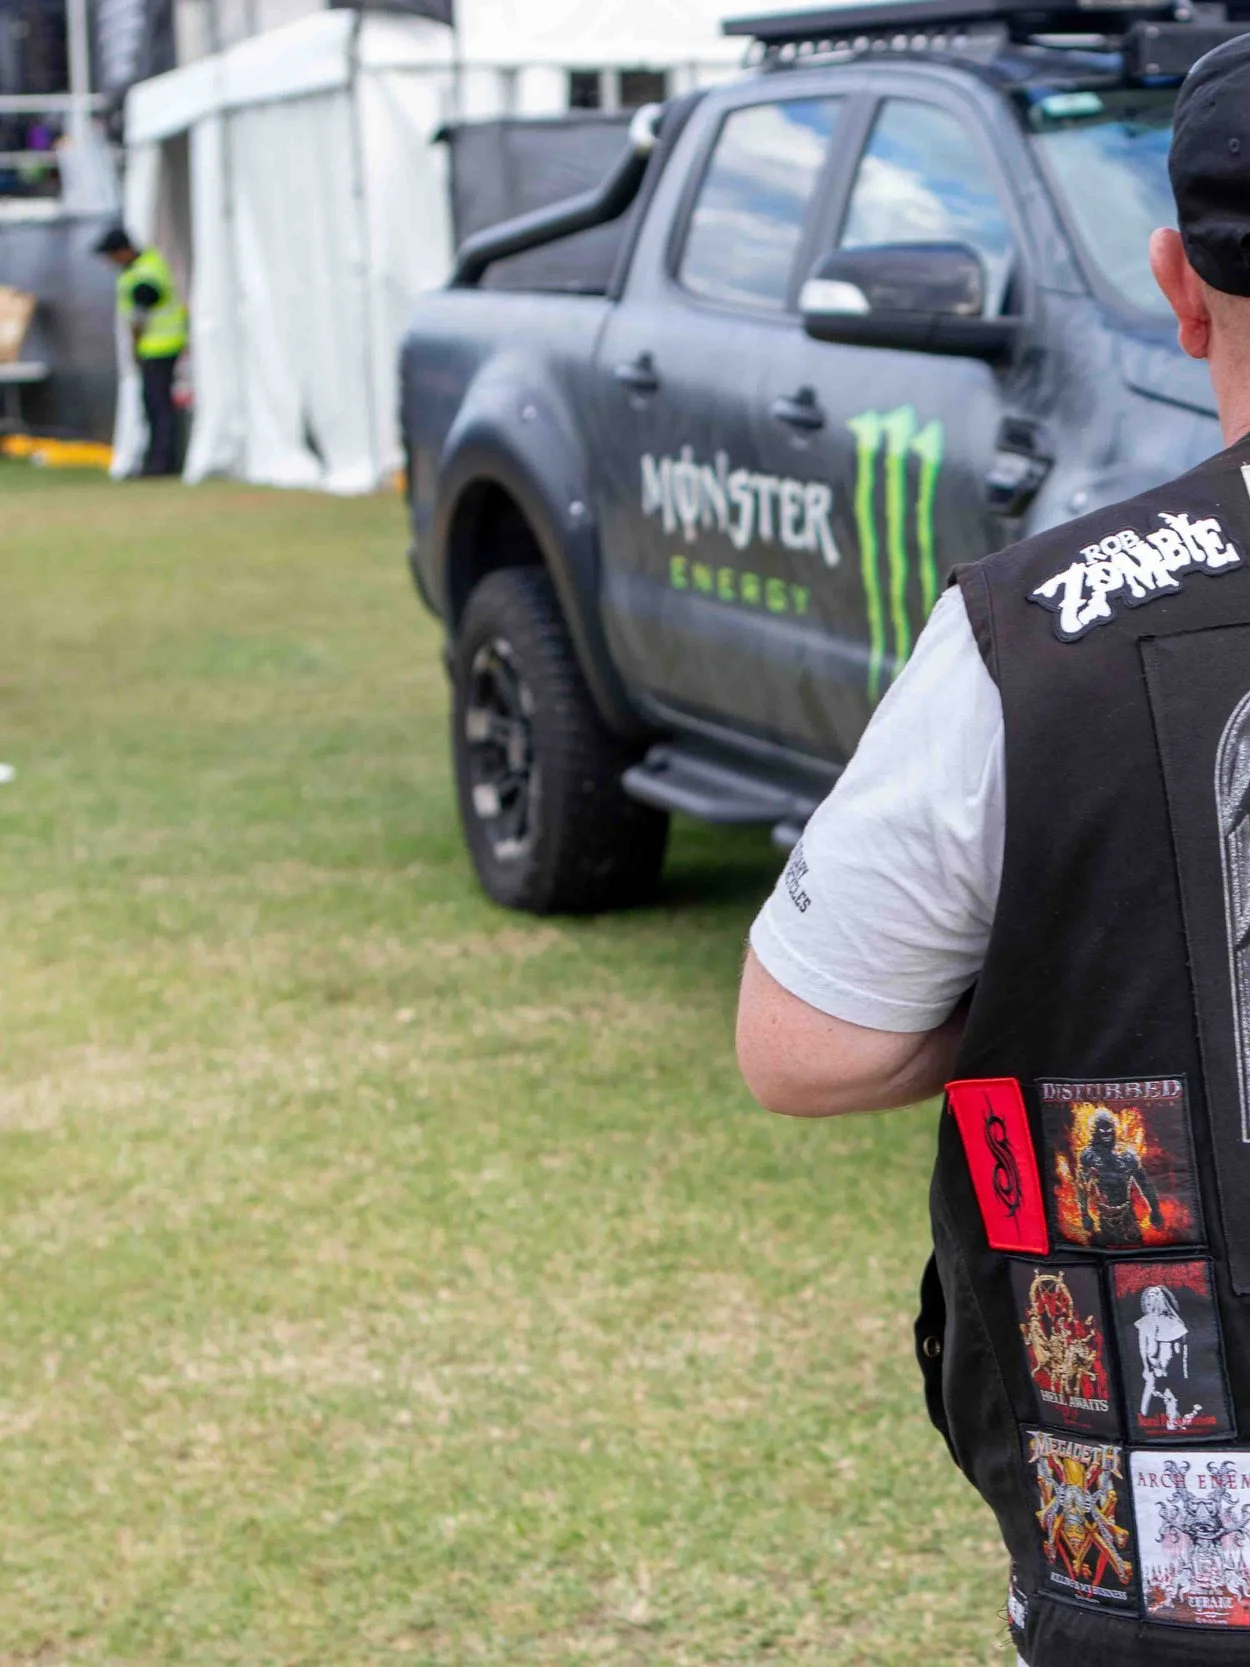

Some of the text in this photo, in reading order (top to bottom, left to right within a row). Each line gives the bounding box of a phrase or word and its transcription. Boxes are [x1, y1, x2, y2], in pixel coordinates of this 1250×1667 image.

[641, 444, 841, 568] MONSTER
[1079, 529, 1141, 564] ROB
[669, 554, 810, 616] ENERGY
[1033, 512, 1241, 634] ZOMBIE
[1042, 1078, 1184, 1101] DISTURBED
[1025, 1430, 1124, 1480] MEGADETH
[1137, 1472, 1188, 1489] ARCH
